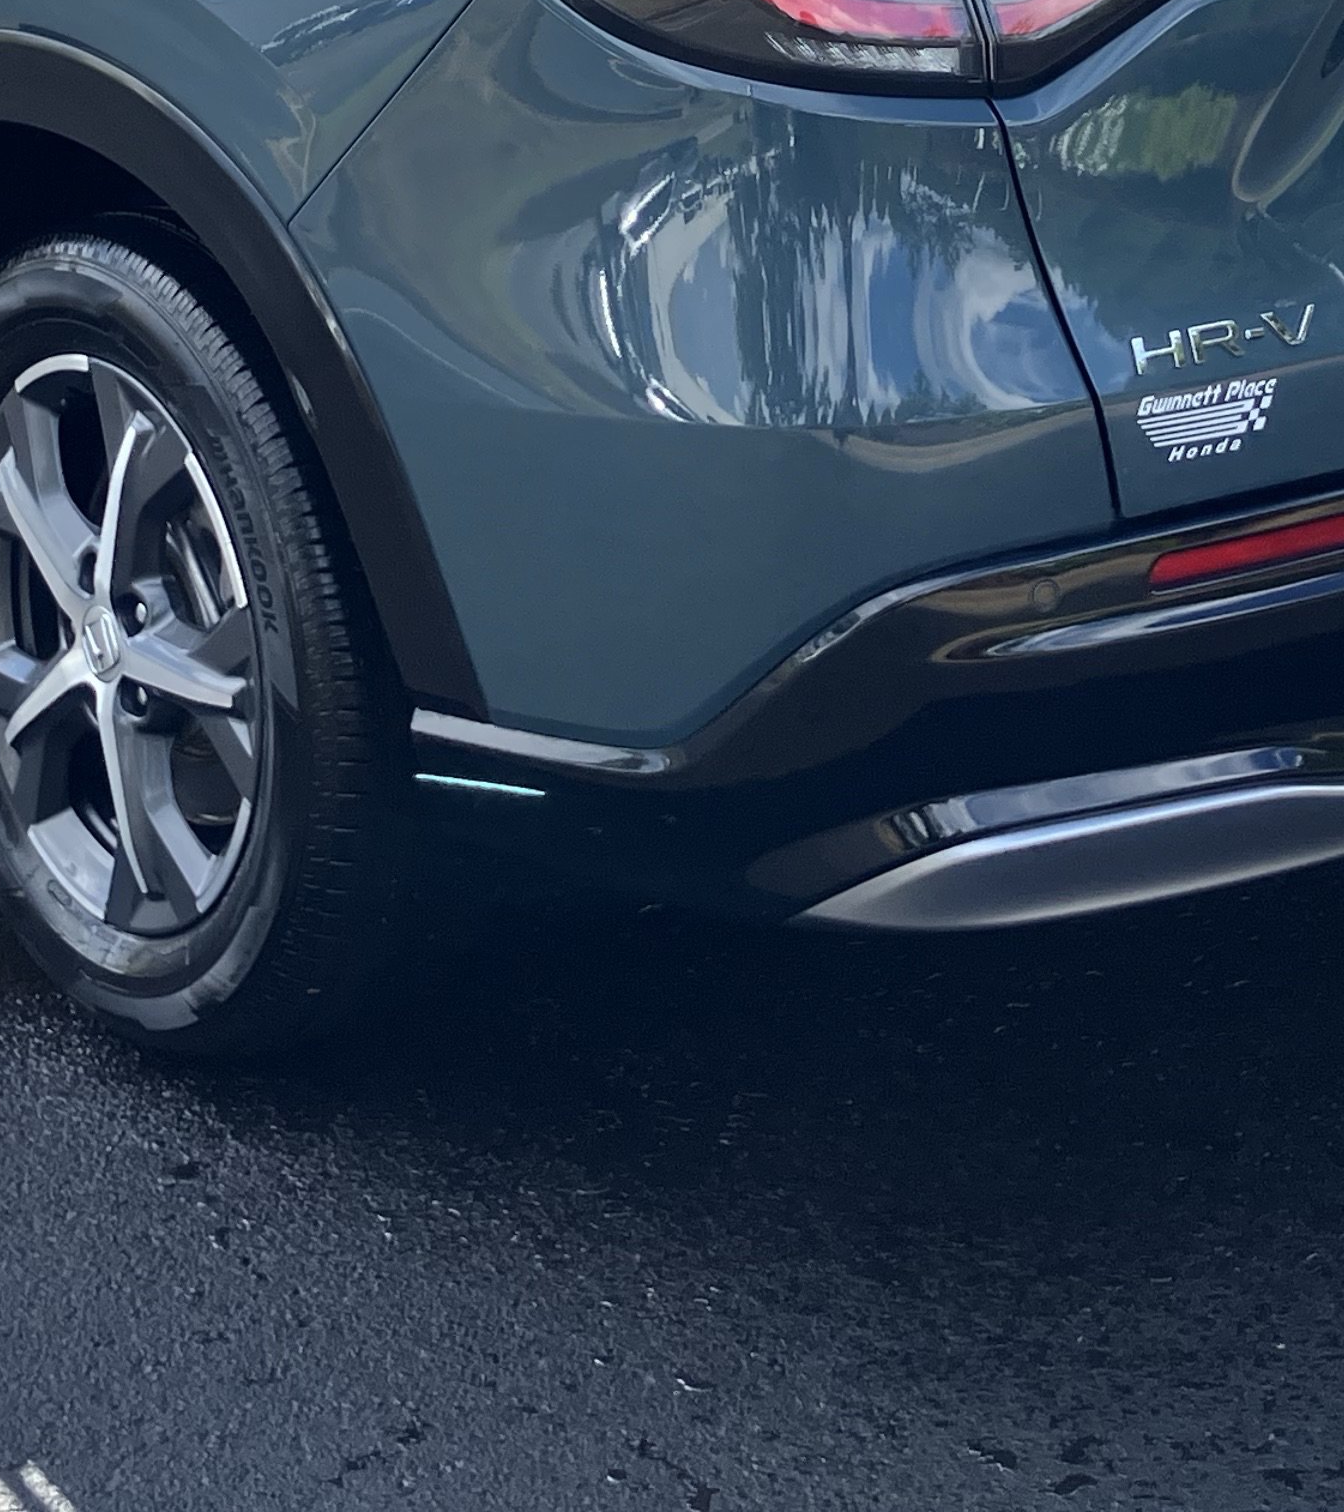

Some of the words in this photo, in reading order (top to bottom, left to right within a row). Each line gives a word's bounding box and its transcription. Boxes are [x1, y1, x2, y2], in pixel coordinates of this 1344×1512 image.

[1130, 303, 1316, 376] HR-V
[1136, 383, 1224, 417] Gwinnett
[1224, 377, 1278, 402] Place
[1167, 437, 1242, 463] Honda
